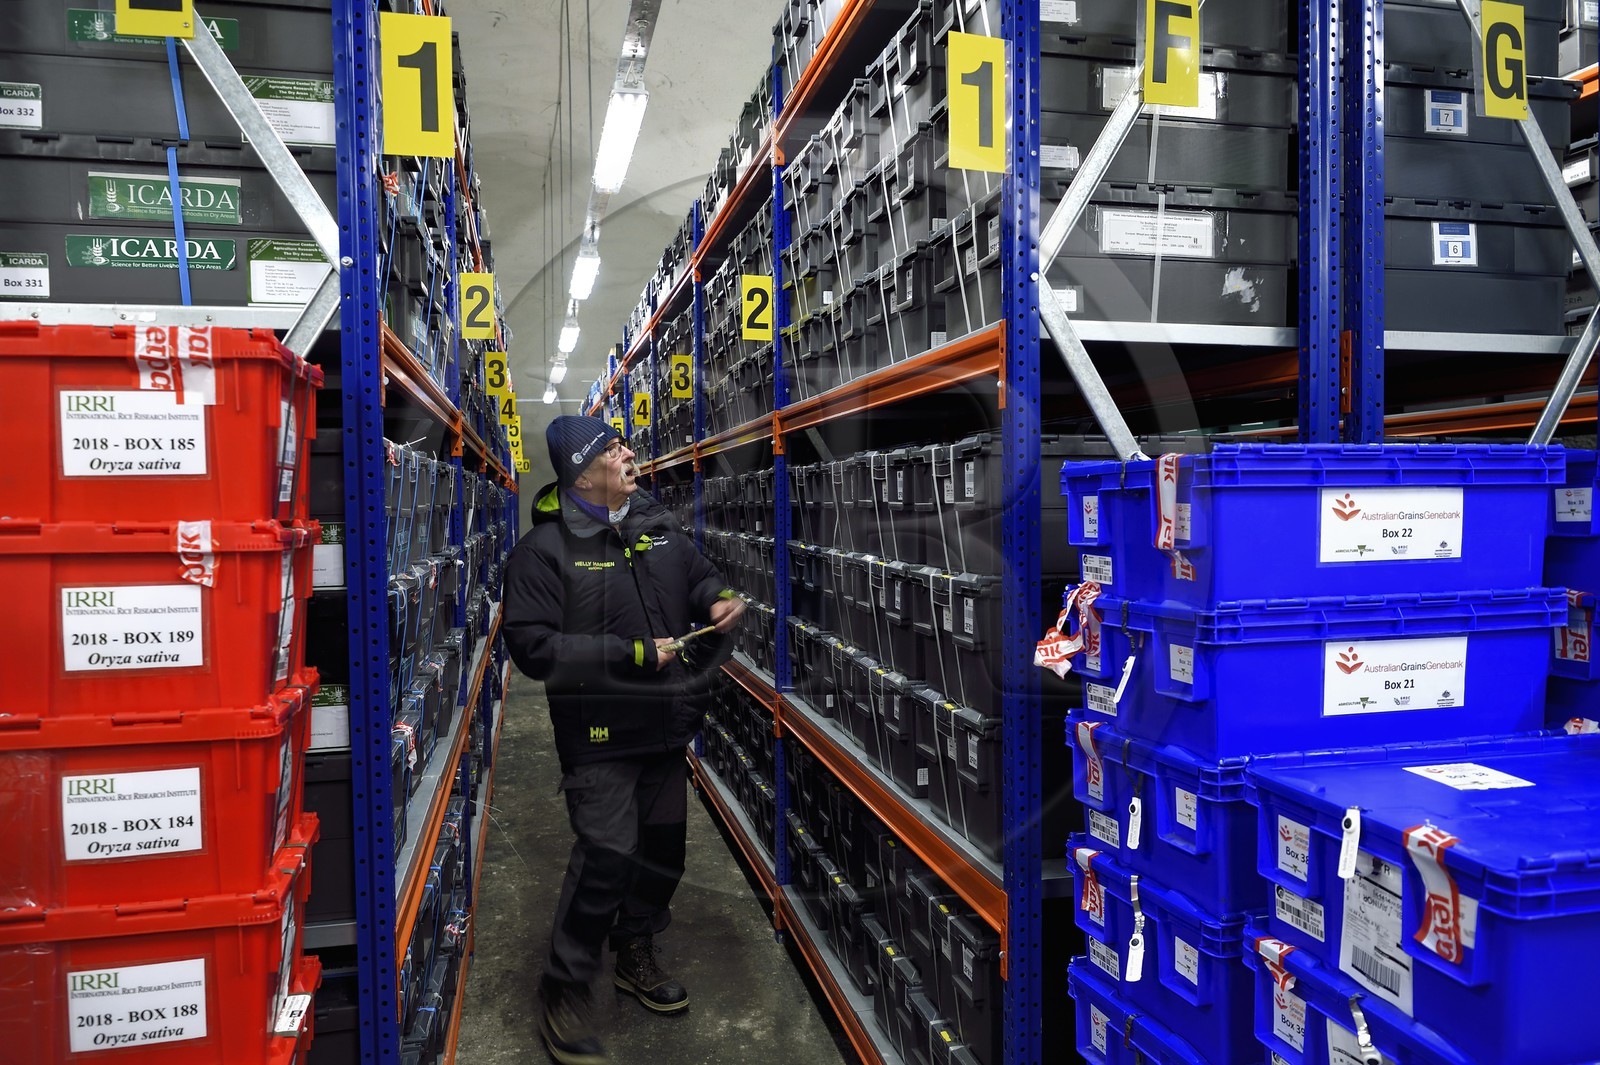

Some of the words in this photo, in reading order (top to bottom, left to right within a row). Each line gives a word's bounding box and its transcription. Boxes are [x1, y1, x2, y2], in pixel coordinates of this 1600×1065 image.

[1152, 1, 1193, 84] F
[1485, 22, 1525, 101] G
[3, 89, 36, 98] ICARDA
[397, 41, 439, 133] 1
[16, 107, 35, 117] 332
[961, 60, 994, 148] 1
[1443, 113, 1450, 123] 7
[127, 184, 236, 211] ICARDA
[110, 238, 222, 260] ICARDA
[1452, 244, 1459, 255] 6
[9, 258, 44, 266] ICARDA
[3, 278, 22, 287] Box
[25, 279, 43, 288] 331
[465, 285, 491, 329] 2
[746, 287, 770, 330] 2
[488, 359, 506, 389] 3
[674, 362, 690, 391] 3
[66, 395, 115, 412] IRRI
[501, 398, 515, 420] 4
[636, 399, 649, 420] 4
[509, 423, 519, 437] 5
[73, 437, 109, 451] 2018
[125, 437, 163, 451] BOX
[170, 438, 195, 451] 185
[89, 457, 133, 473] Oryza
[138, 458, 181, 471] sativa
[1361, 510, 1461, 521] AustralianGrainsGenebank
[1382, 528, 1400, 538] Box
[1401, 528, 1413, 538] 22
[66, 591, 115, 608] IRRI
[72, 633, 108, 646] 2018
[124, 632, 163, 645] BOX
[169, 630, 195, 643] 189
[88, 652, 132, 668] Oryza
[136, 651, 181, 664] sativa
[1364, 660, 1464, 673] AustralianGrainsGenebank
[1384, 680, 1402, 690] Box
[1404, 679, 1415, 689] 21
[589, 726, 609, 739] HH
[67, 778, 116, 796] IRRI
[71, 821, 107, 836] 2018
[123, 818, 162, 832] BOX
[169, 815, 194, 829] 184
[87, 841, 132, 856] Oryza
[136, 836, 181, 850] sativa
[1285, 846, 1300, 861] Box
[71, 971, 120, 992] IRRI
[77, 1013, 113, 1028] 2018
[128, 1007, 167, 1023] BOX
[172, 1003, 199, 1018] 188
[1281, 1014, 1296, 1031] Box
[93, 1032, 137, 1047] Oryza
[141, 1026, 185, 1040] sativa
